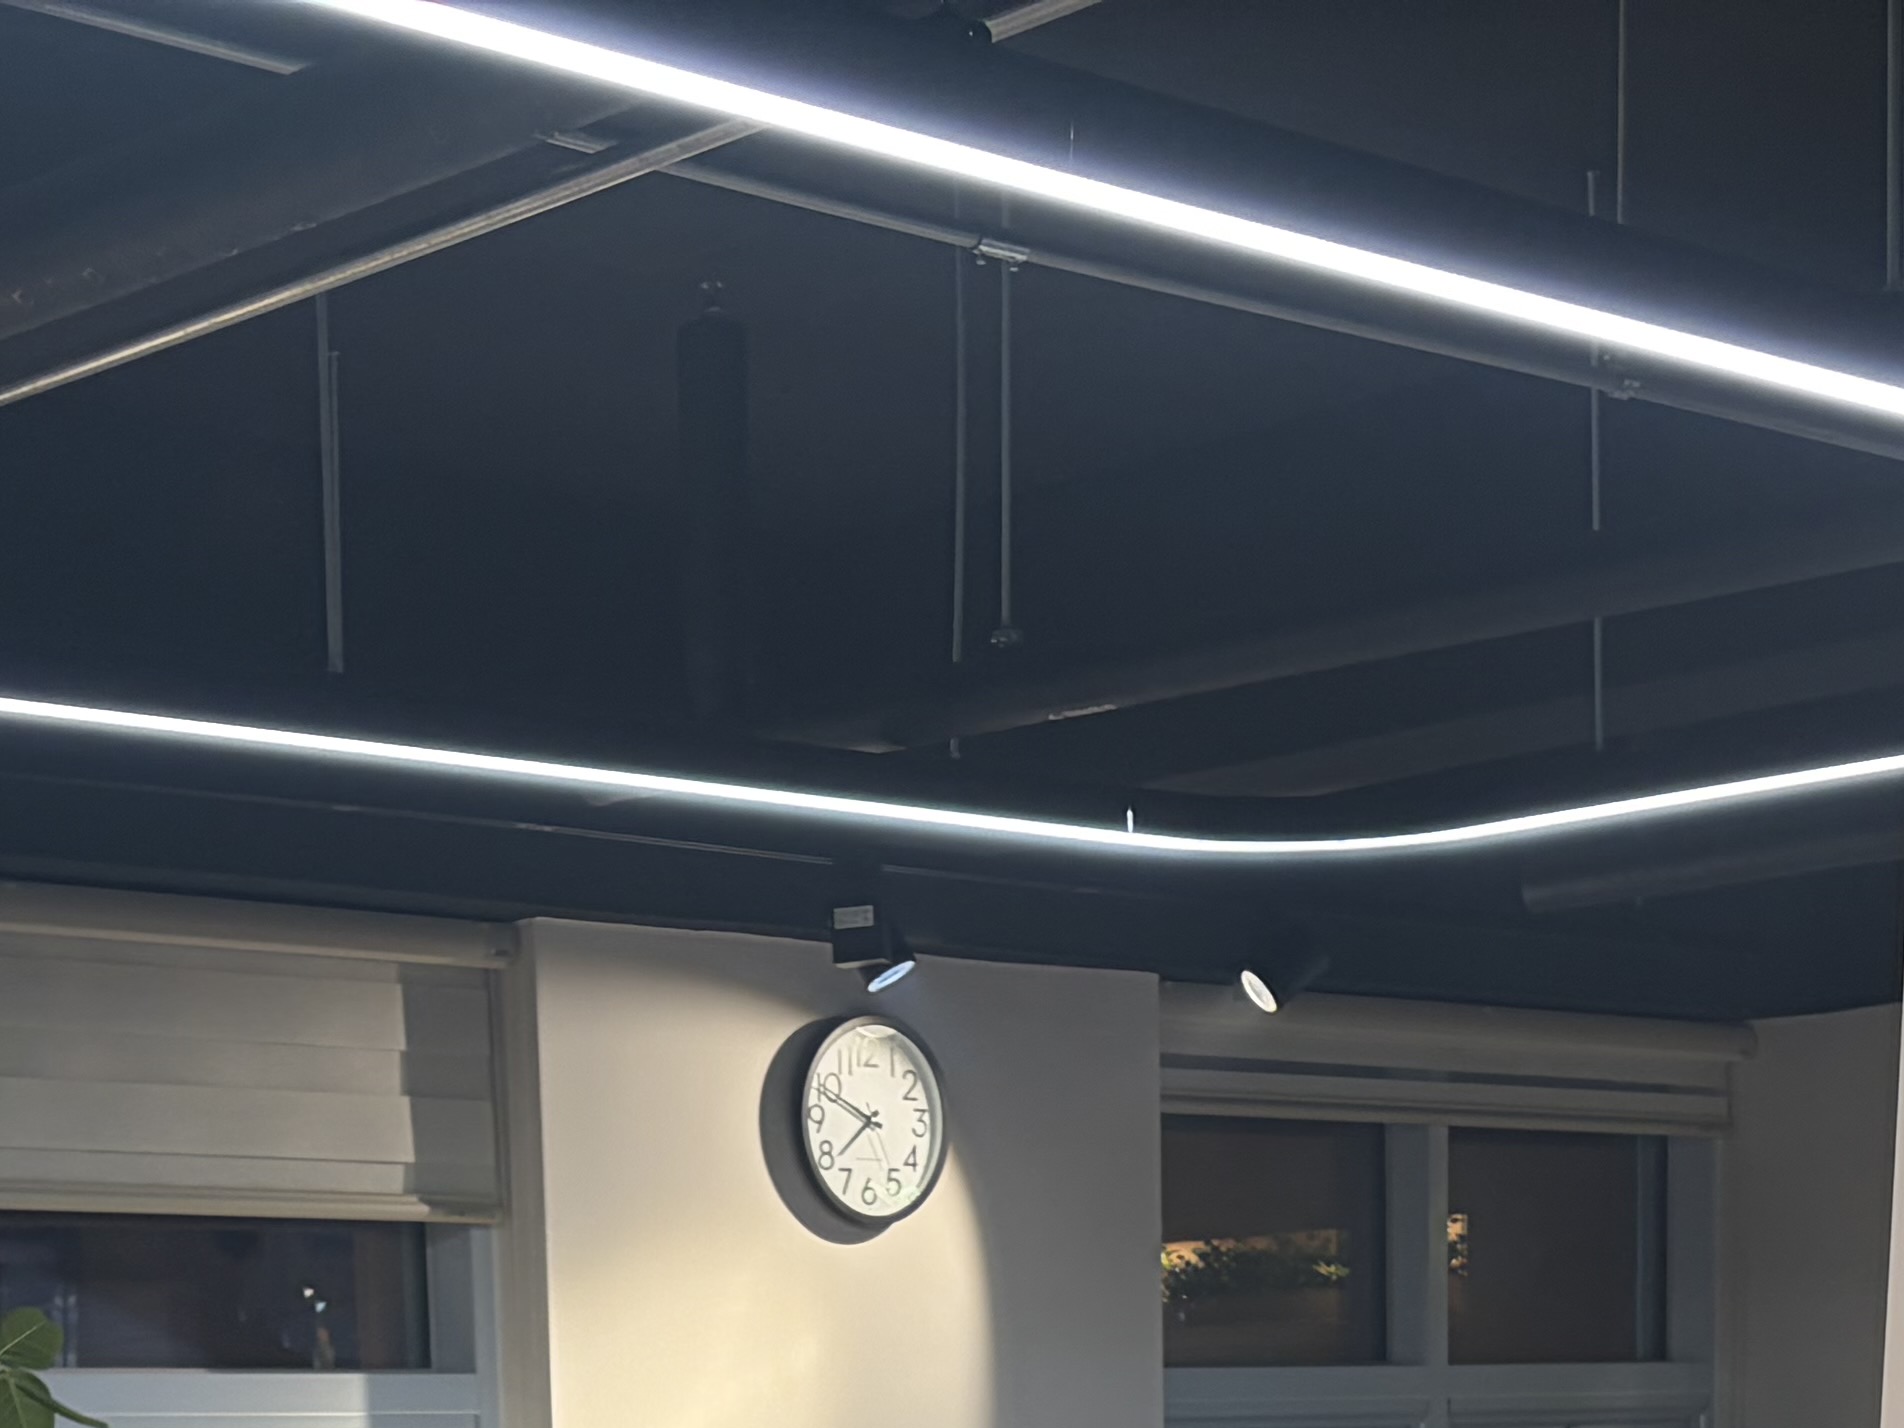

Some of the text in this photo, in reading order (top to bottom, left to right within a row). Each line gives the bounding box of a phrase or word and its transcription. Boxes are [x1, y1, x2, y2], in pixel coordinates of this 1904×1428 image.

[838, 1045, 853, 1076] 11
[816, 1072, 842, 1102] 10
[902, 1069, 919, 1101] 2
[808, 1104, 825, 1134] 9
[911, 1108, 929, 1138] 3
[818, 1140, 835, 1170] 8
[903, 1144, 918, 1172] 4
[838, 1168, 853, 1196] 7
[861, 1177, 877, 1205] 6
[886, 1168, 902, 1197] 5
